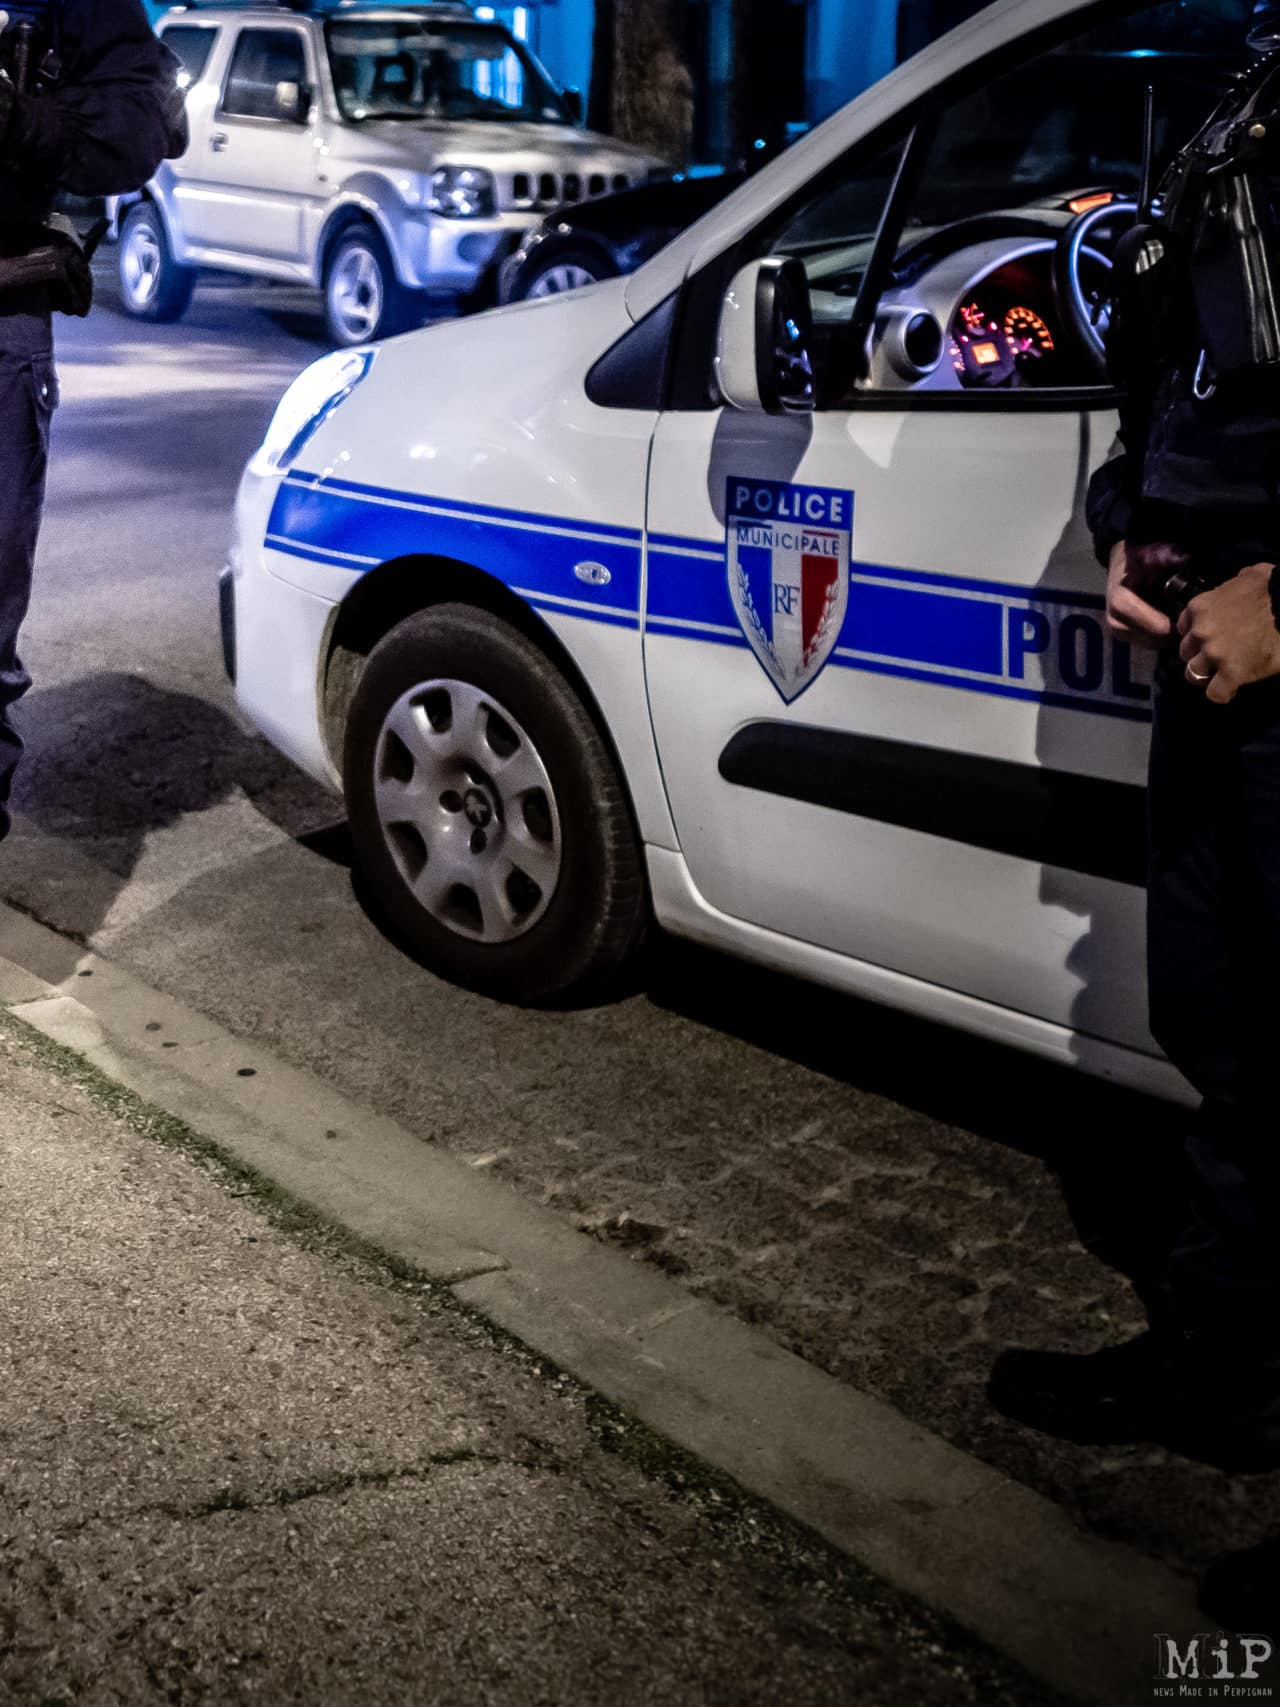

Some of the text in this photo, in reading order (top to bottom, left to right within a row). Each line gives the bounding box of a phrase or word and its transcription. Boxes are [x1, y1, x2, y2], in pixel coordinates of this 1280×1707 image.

[735, 485, 843, 523] POLICE
[736, 526, 839, 556] MUNICIPALE
[774, 583, 800, 616] RF
